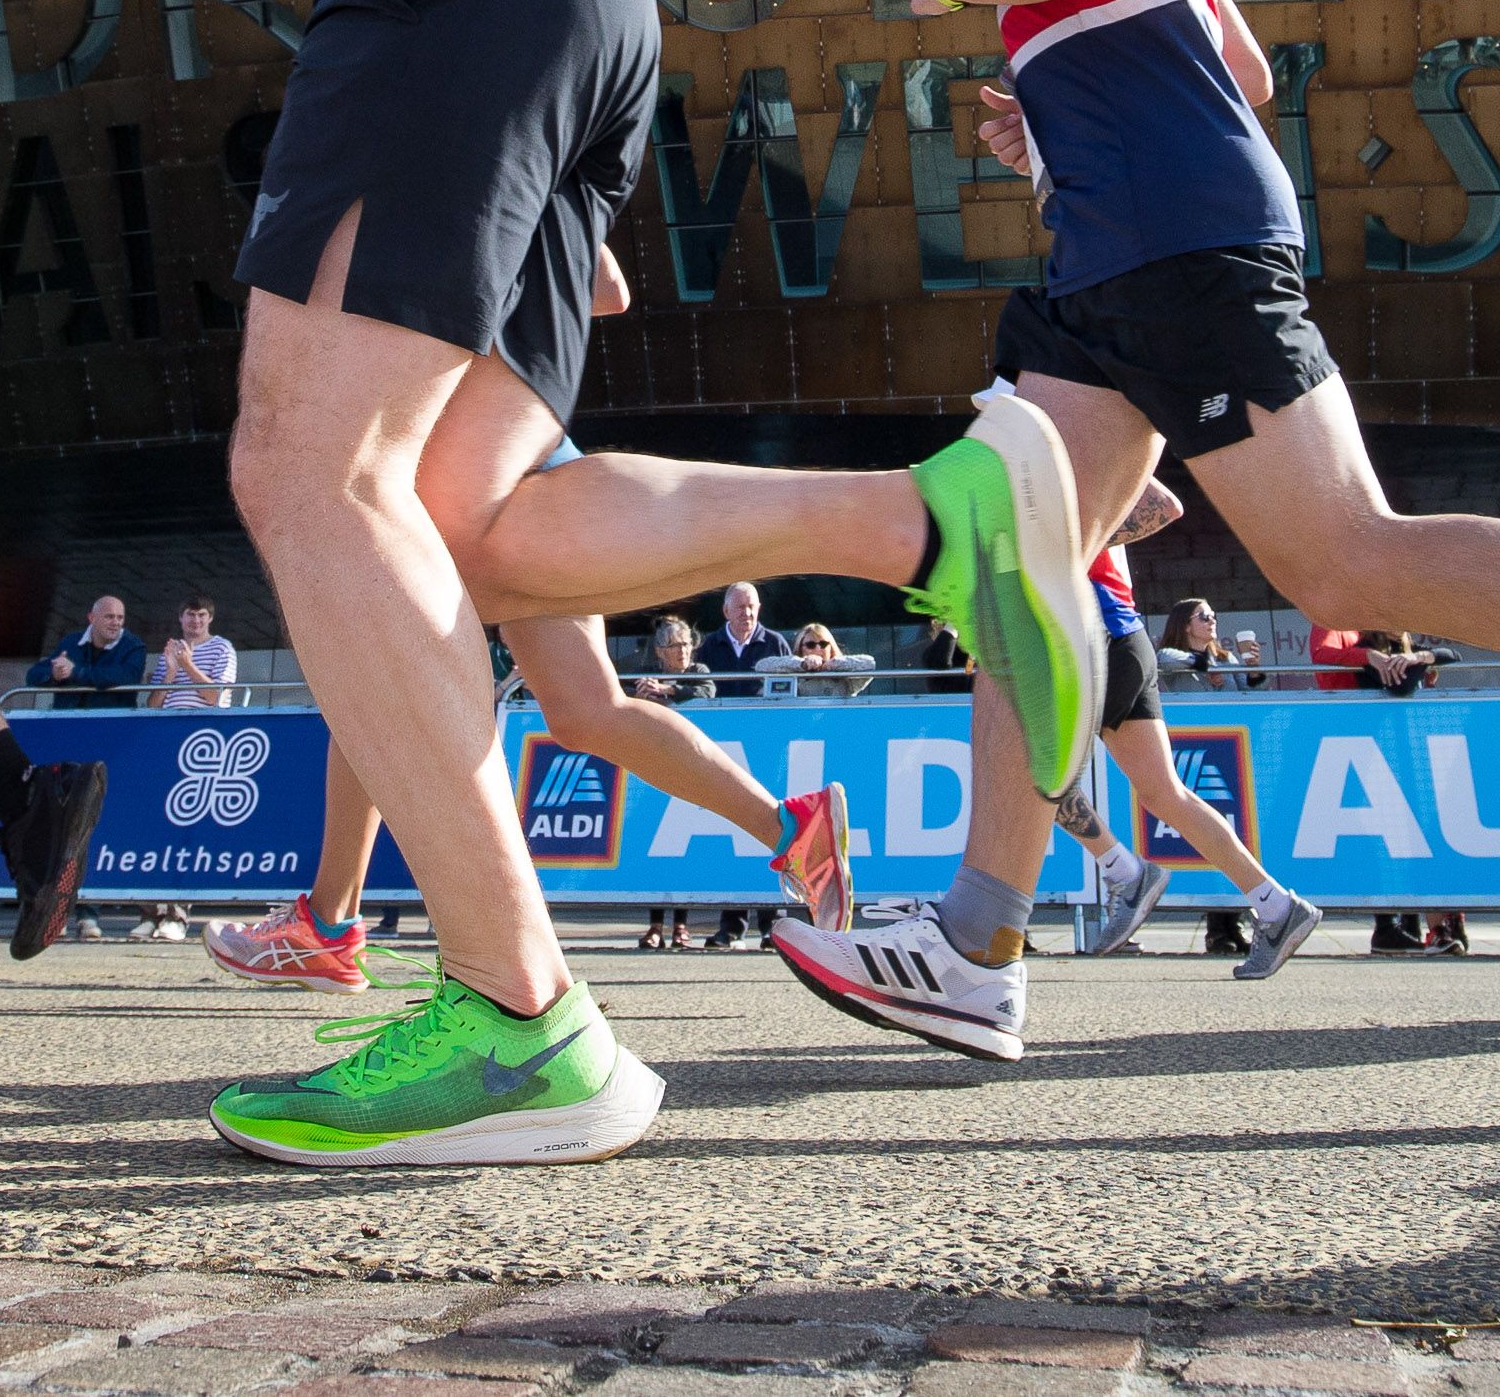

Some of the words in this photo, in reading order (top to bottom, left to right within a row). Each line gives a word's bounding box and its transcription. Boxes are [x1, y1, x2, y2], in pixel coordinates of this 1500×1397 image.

[647, 738, 1055, 858] ALD
[529, 813, 604, 840] ALDI
[1154, 814, 1236, 839] AI
[96, 844, 299, 879] healthspan
